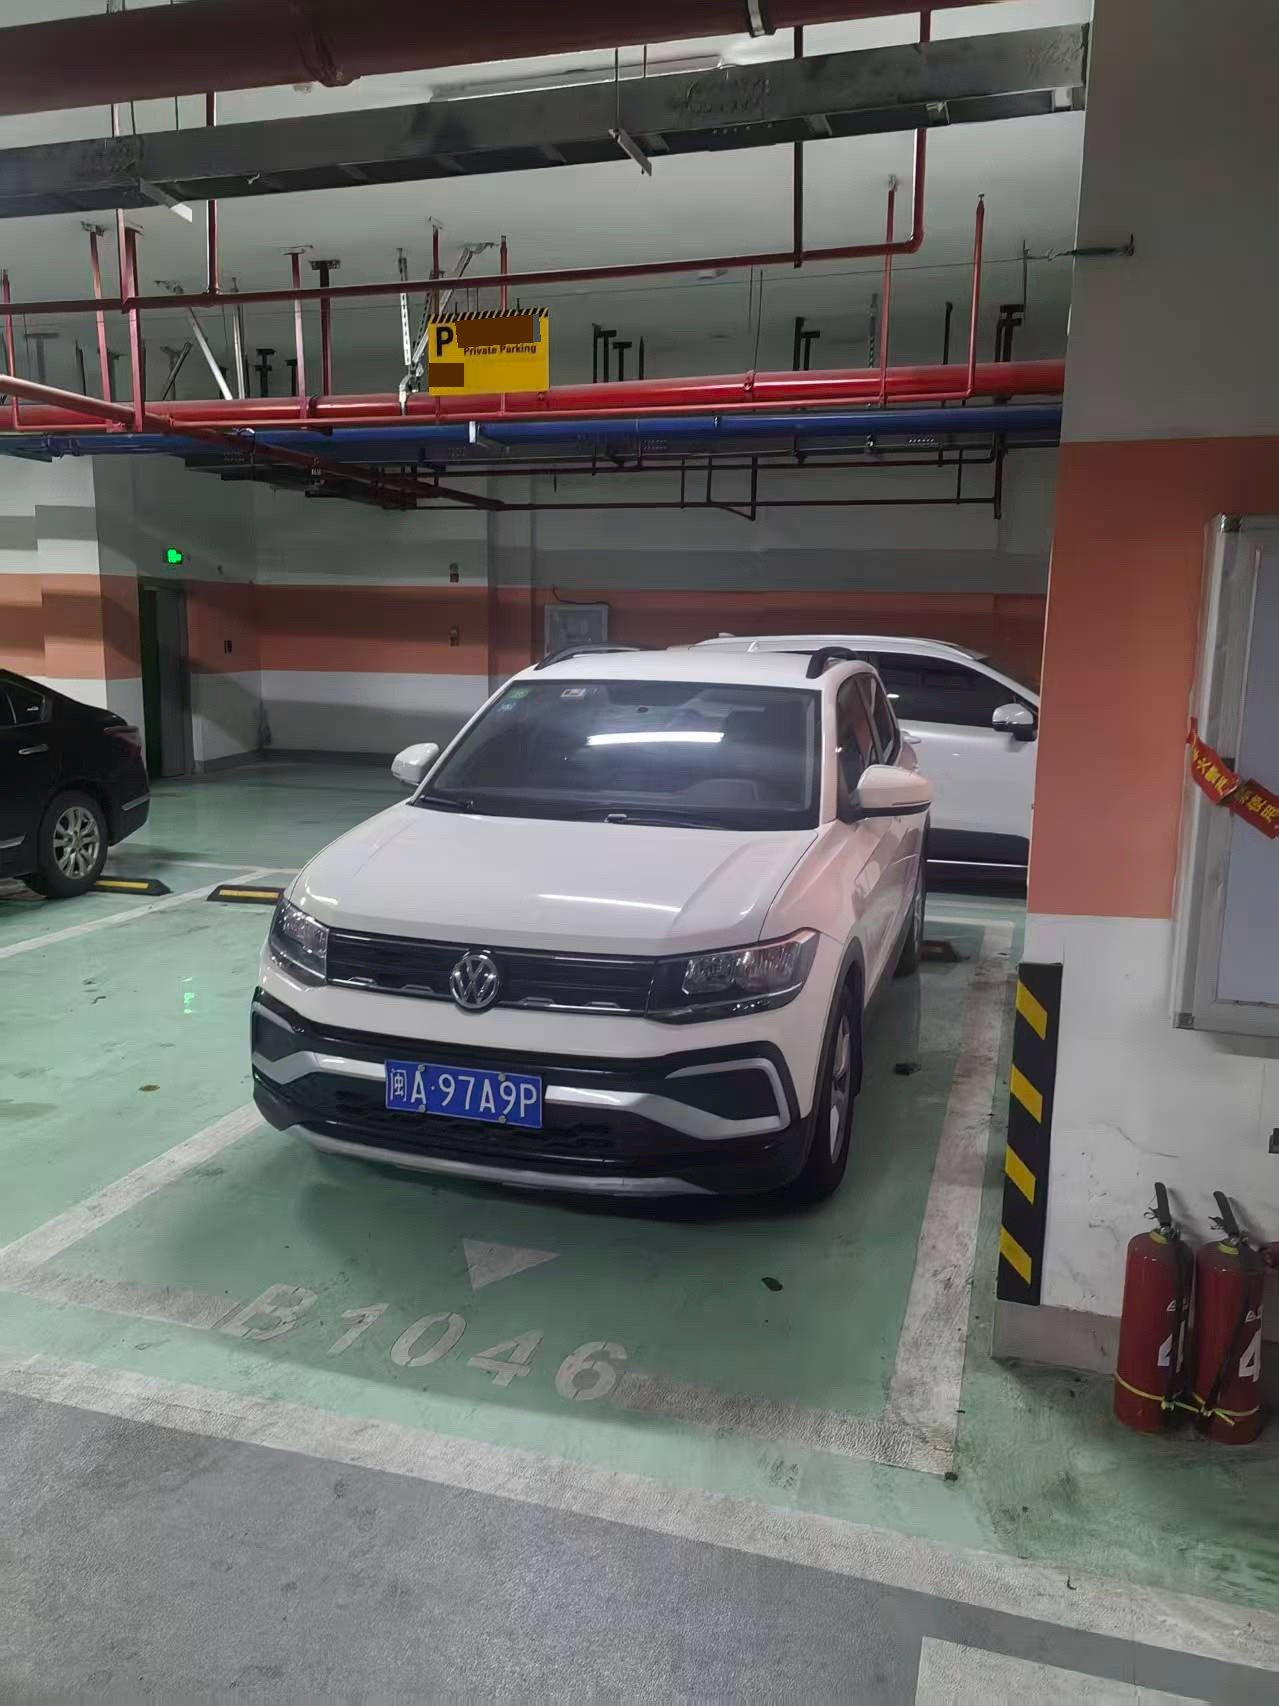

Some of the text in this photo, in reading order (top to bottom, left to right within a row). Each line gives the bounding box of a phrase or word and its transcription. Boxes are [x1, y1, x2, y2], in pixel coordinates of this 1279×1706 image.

[436, 326, 453, 357] P
[464, 344, 537, 355] Private Parking
[218, 1283, 628, 1400] B1046
